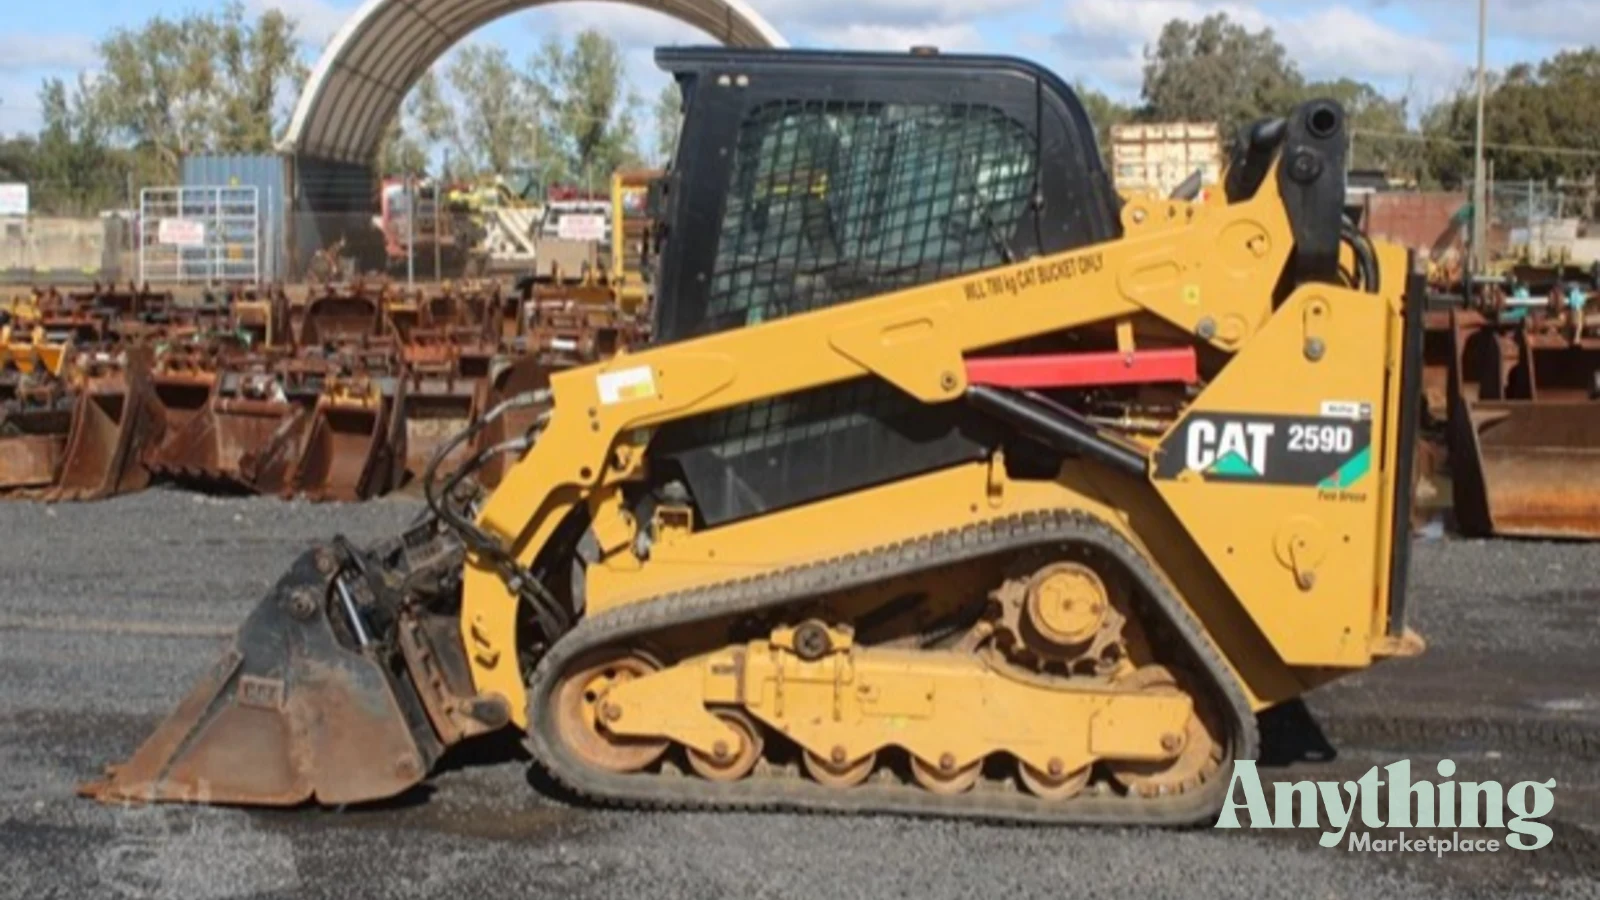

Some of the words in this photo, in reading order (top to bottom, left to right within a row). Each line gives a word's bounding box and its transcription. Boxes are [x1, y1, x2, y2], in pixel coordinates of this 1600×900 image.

[1017, 267, 1036, 289] CAT
[1037, 258, 1075, 285] BUCKET
[1078, 252, 1104, 275] ONLY
[1186, 419, 1275, 476] CAT
[1287, 425, 1353, 452] 259D
